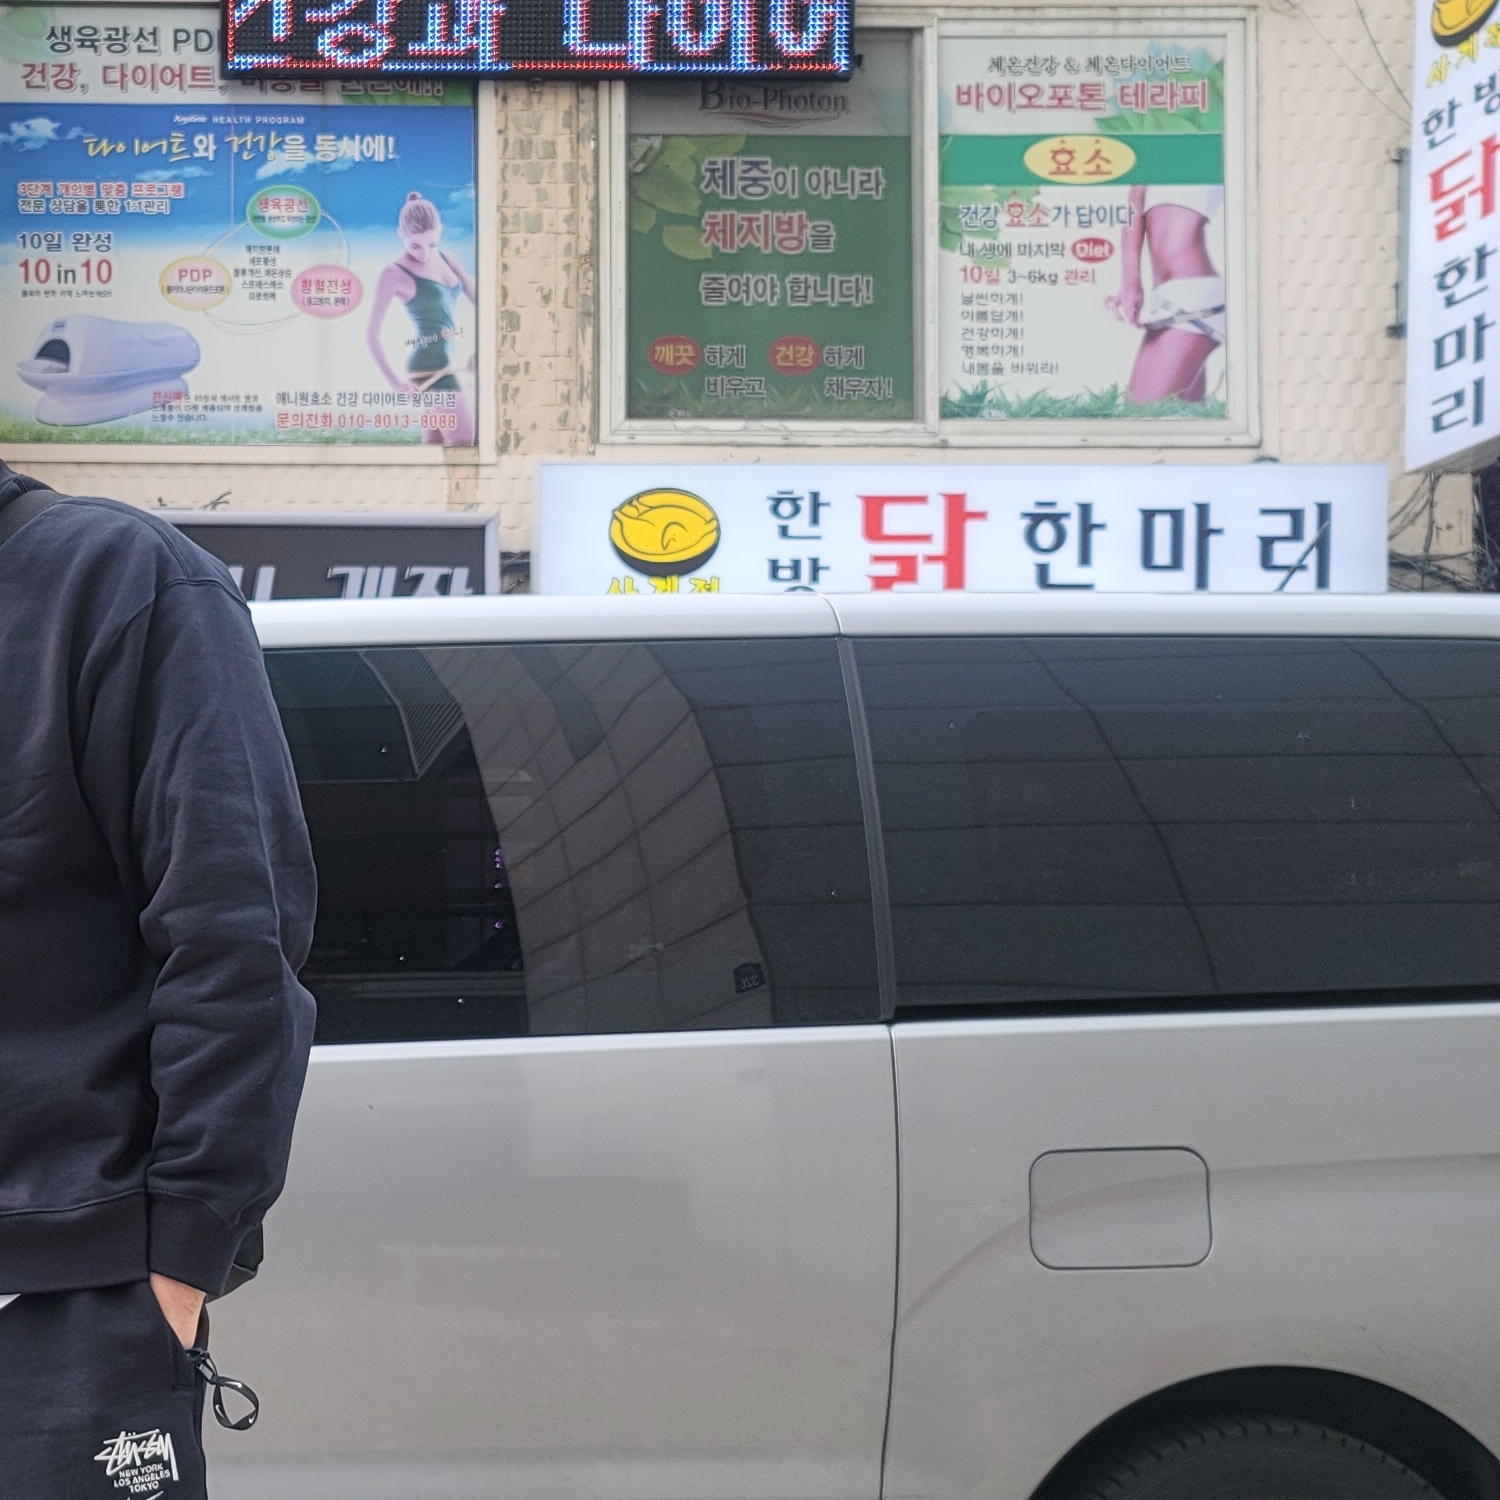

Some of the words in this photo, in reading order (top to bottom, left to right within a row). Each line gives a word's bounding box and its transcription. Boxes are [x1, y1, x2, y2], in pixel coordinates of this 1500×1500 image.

[45, 25, 162, 55] 생육광선
[173, 28, 220, 53] PD
[988, 55, 1057, 75] 체온건강
[20, 62, 90, 94] 건강,
[102, 62, 228, 94] 다이어트,
[699, 80, 850, 112] Bio-Photon
[956, 82, 1108, 113] 바이오포톤
[1117, 81, 1209, 113] 테라피
[255, 115, 305, 124] PROGRAM
[83, 131, 218, 163] 다이어트와
[224, 130, 307, 163] 건강을
[313, 134, 396, 163] 동시에!
[1048, 140, 1113, 177] 효소
[703, 160, 797, 197] 체중이
[808, 166, 884, 198] 아니라
[57, 183, 96, 198] 개인별
[101, 183, 127, 198] 맞춤
[132, 183, 184, 198] 프로그램
[20, 199, 45, 214] 전문
[959, 204, 1000, 230] 건강
[1005, 199, 1071, 229] 효소가
[1076, 204, 1136, 229] 답이다
[703, 213, 834, 251] 체지방을
[18, 232, 63, 253] 10일
[70, 232, 113, 253] 완성
[959, 241, 976, 258] 내
[1017, 241, 1066, 259] 마지막
[1076, 240, 1112, 259] Diet
[18, 258, 52, 285] 10
[56, 262, 77, 285] in
[81, 258, 113, 285] 10
[178, 269, 213, 282] PDP
[960, 266, 1001, 285] 10일
[701, 275, 779, 305] 줄여야
[788, 276, 873, 306] 합니다!
[704, 346, 746, 368] 하게
[774, 344, 816, 368] 건강
[824, 346, 865, 368] 하게
[705, 378, 766, 397] 비우고
[825, 379, 893, 398] 채우자!
[337, 391, 359, 407] 건강
[362, 391, 408, 407] 다이어트
[276, 412, 333, 429] 문의전화
[113, 1477, 131, 1488] LOS
[132, 1469, 171, 1484] ANGELES
[118, 1466, 139, 1479] NEW
[140, 1462, 164, 1474] YORK
[128, 1480, 160, 1493] TOKYO
